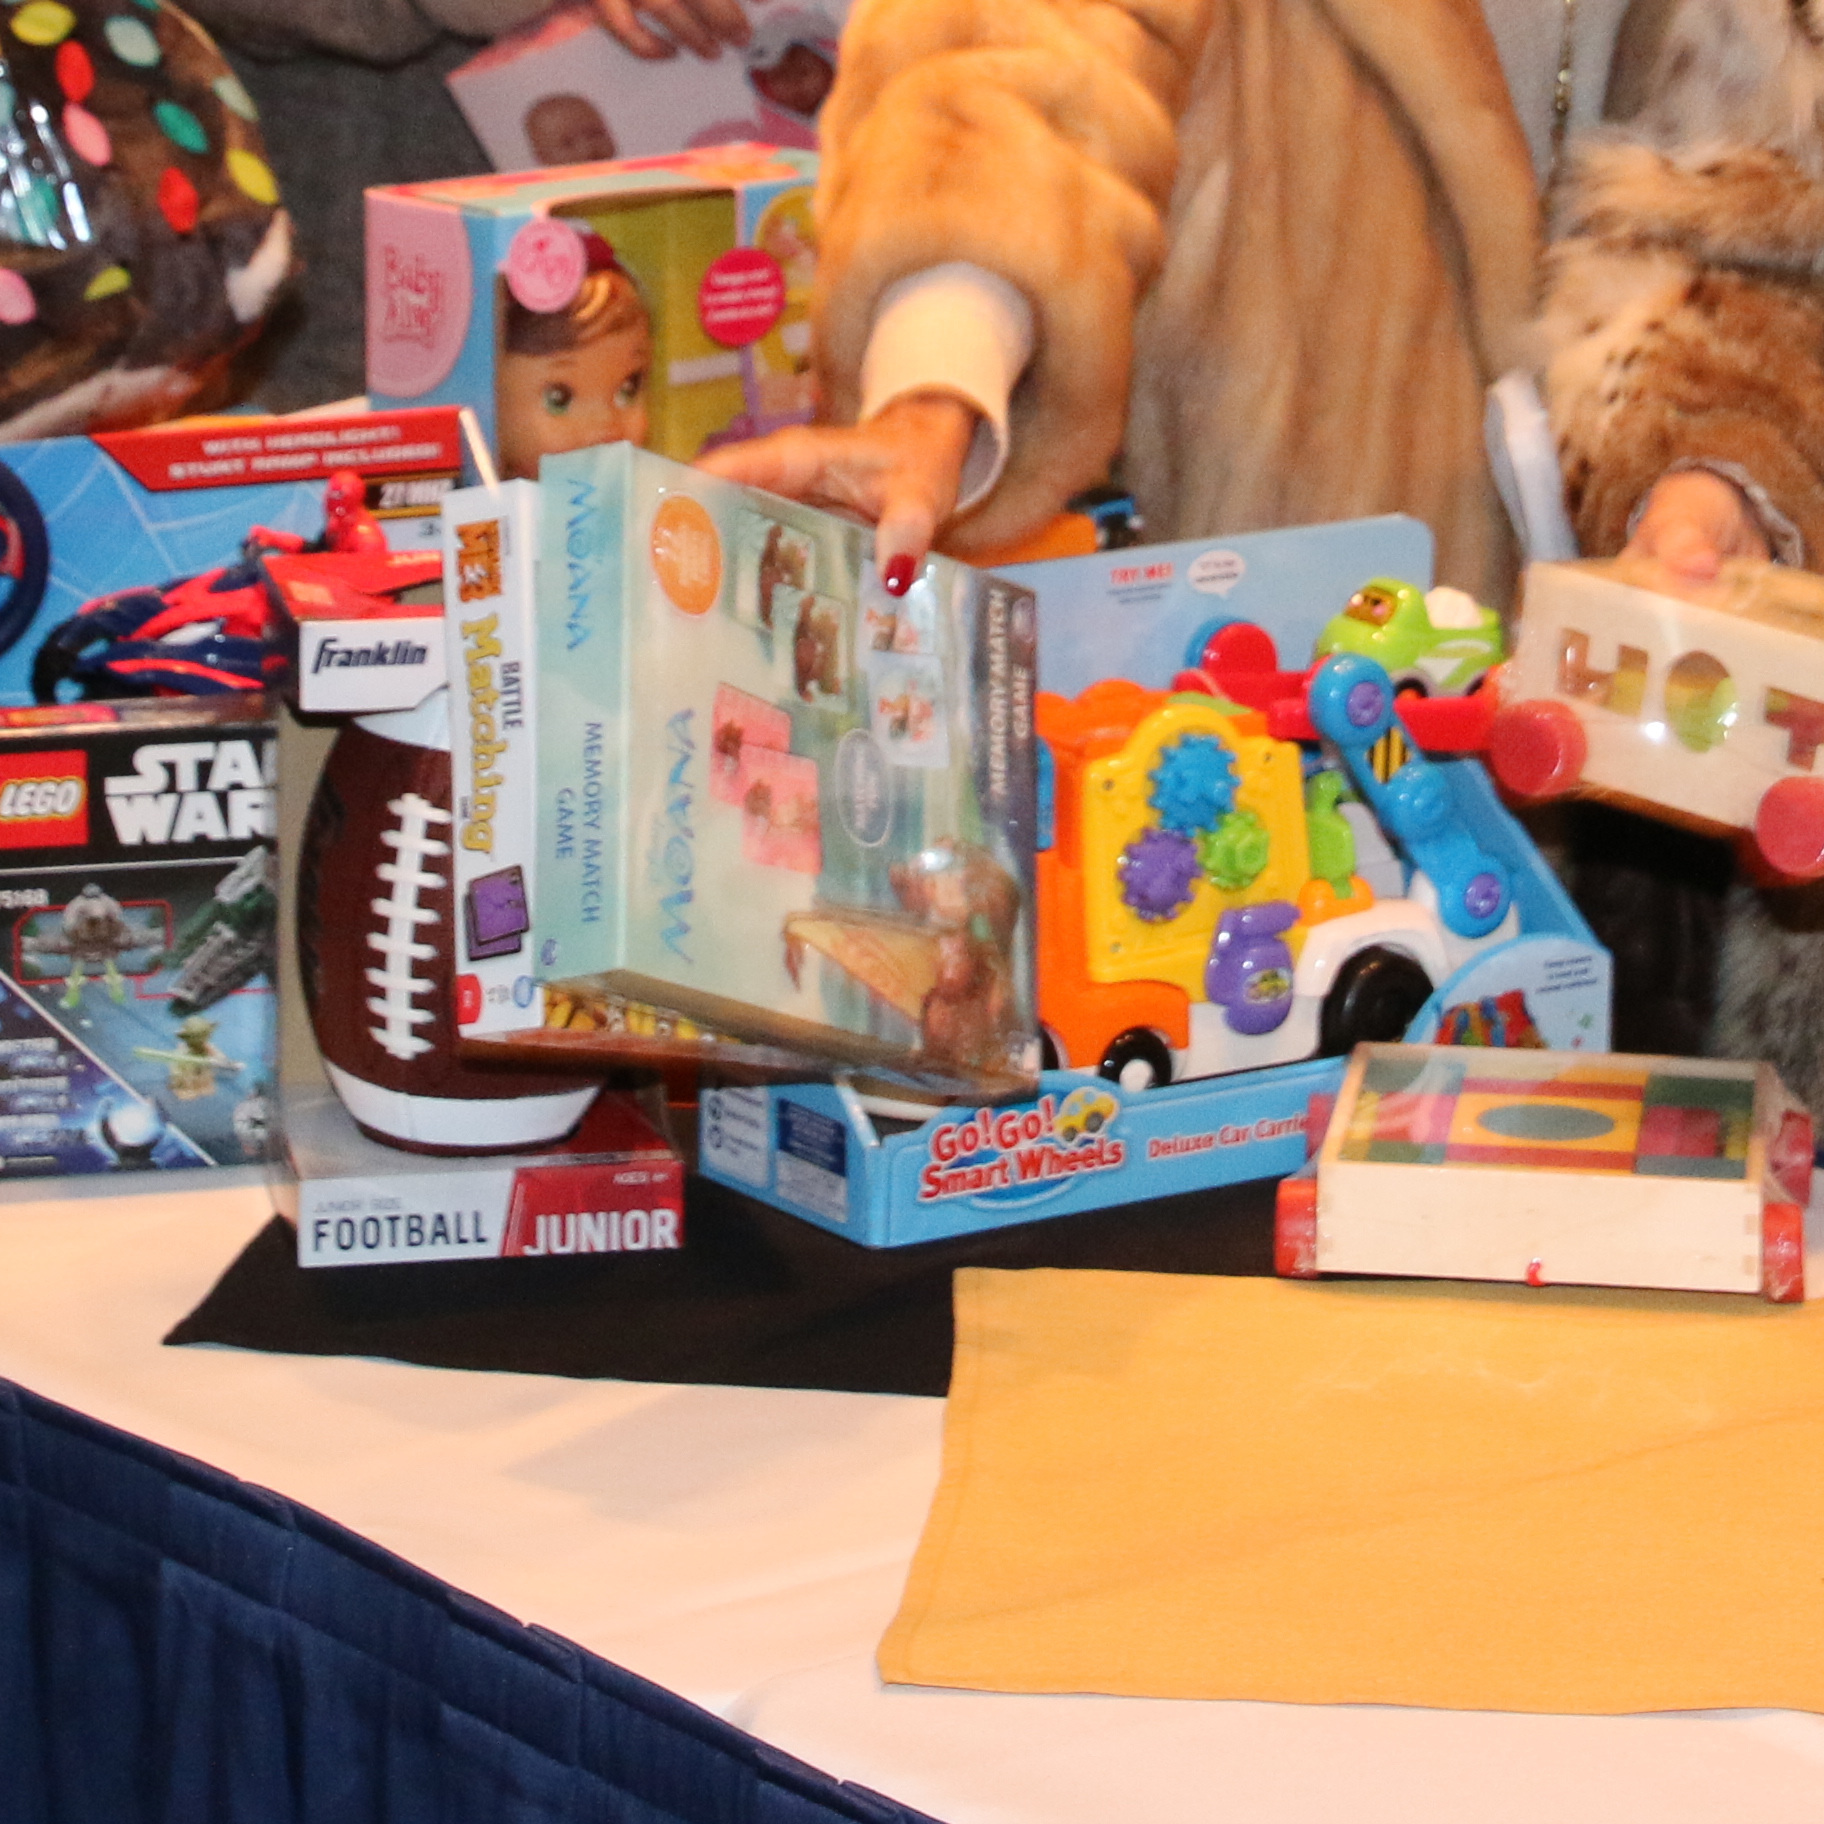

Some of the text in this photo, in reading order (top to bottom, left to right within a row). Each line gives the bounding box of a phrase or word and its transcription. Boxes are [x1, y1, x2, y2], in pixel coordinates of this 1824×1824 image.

[565, 478, 598, 652] MOANA
[501, 661, 524, 731] BATTLE
[461, 612, 509, 855] Matching
[555, 786, 575, 861] GAME
[580, 722, 604, 924] MEMORY MATCH
[918, 1138, 1125, 1202] Smart Wheels
[1148, 1132, 1214, 1161] Deluxe
[1220, 1124, 1250, 1145] Car
[312, 1210, 488, 1252] FOOTBALL
[521, 1208, 681, 1257] JUNIOR
